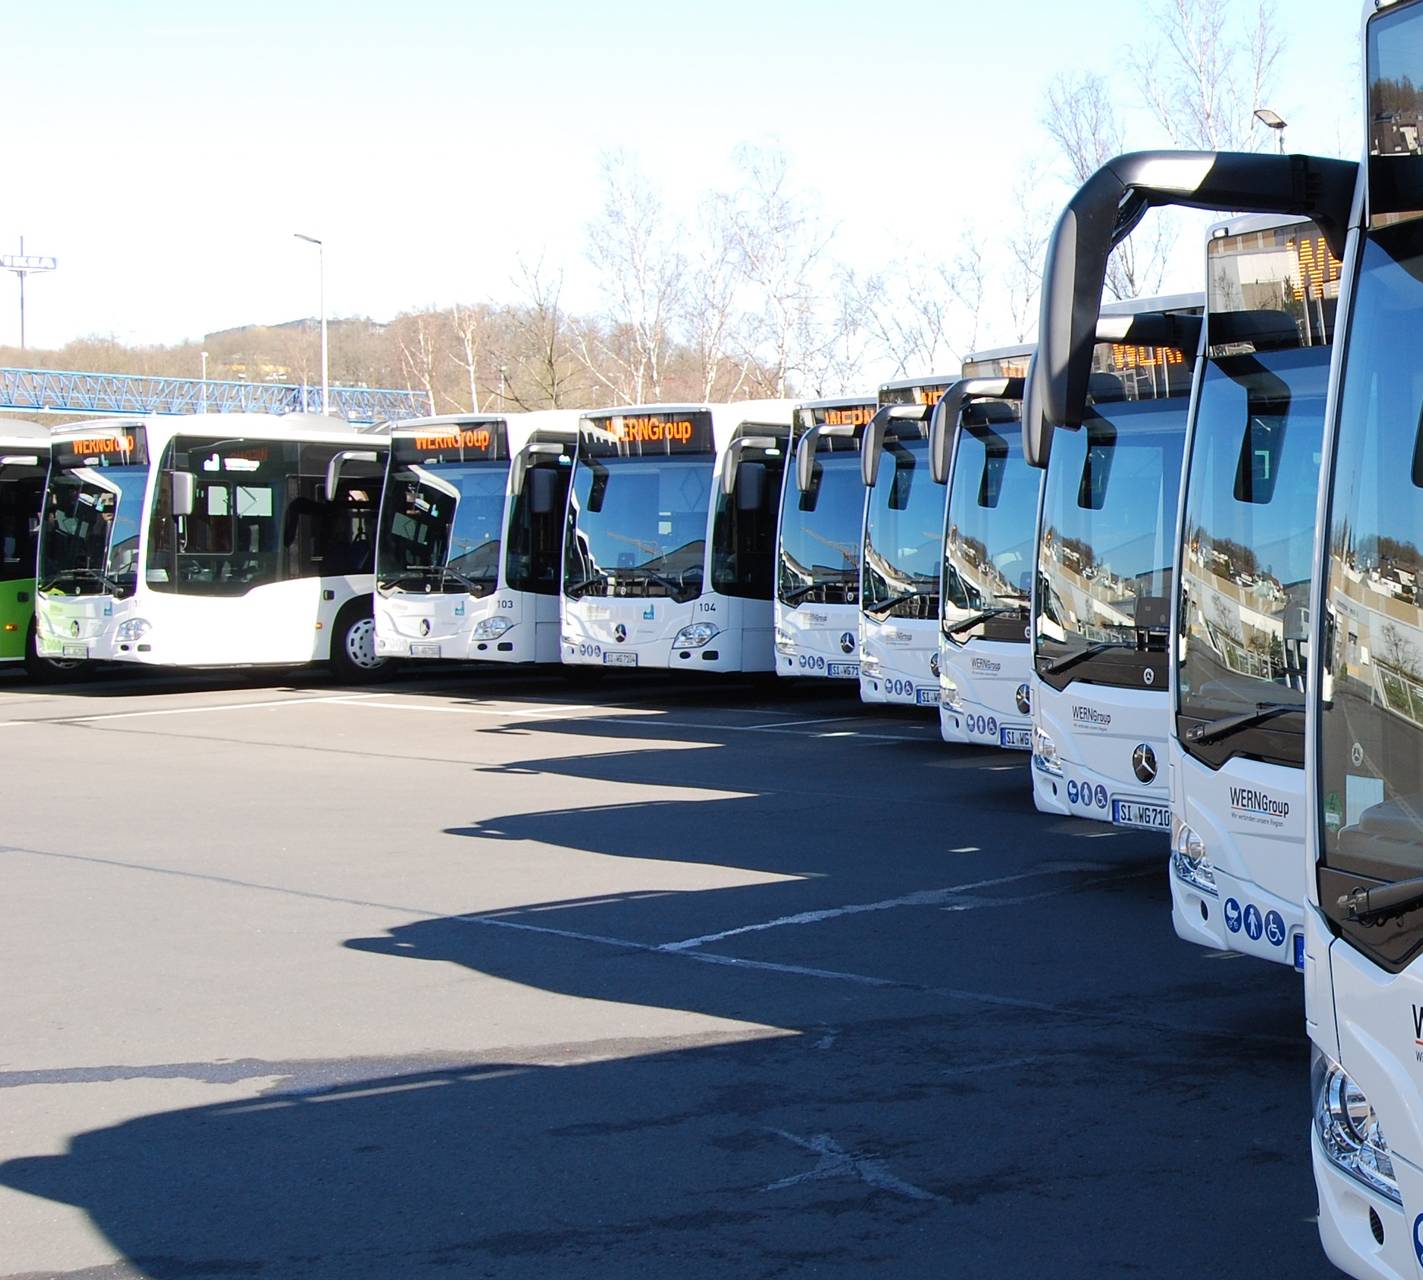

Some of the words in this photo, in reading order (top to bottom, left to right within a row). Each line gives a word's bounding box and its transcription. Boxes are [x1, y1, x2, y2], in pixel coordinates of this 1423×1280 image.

[497, 600, 514, 609] 103
[699, 603, 716, 612] 104
[1072, 705, 1111, 725] WERNGroup
[1229, 786, 1290, 819] WERNGroup
[1120, 804, 1132, 822] SI
